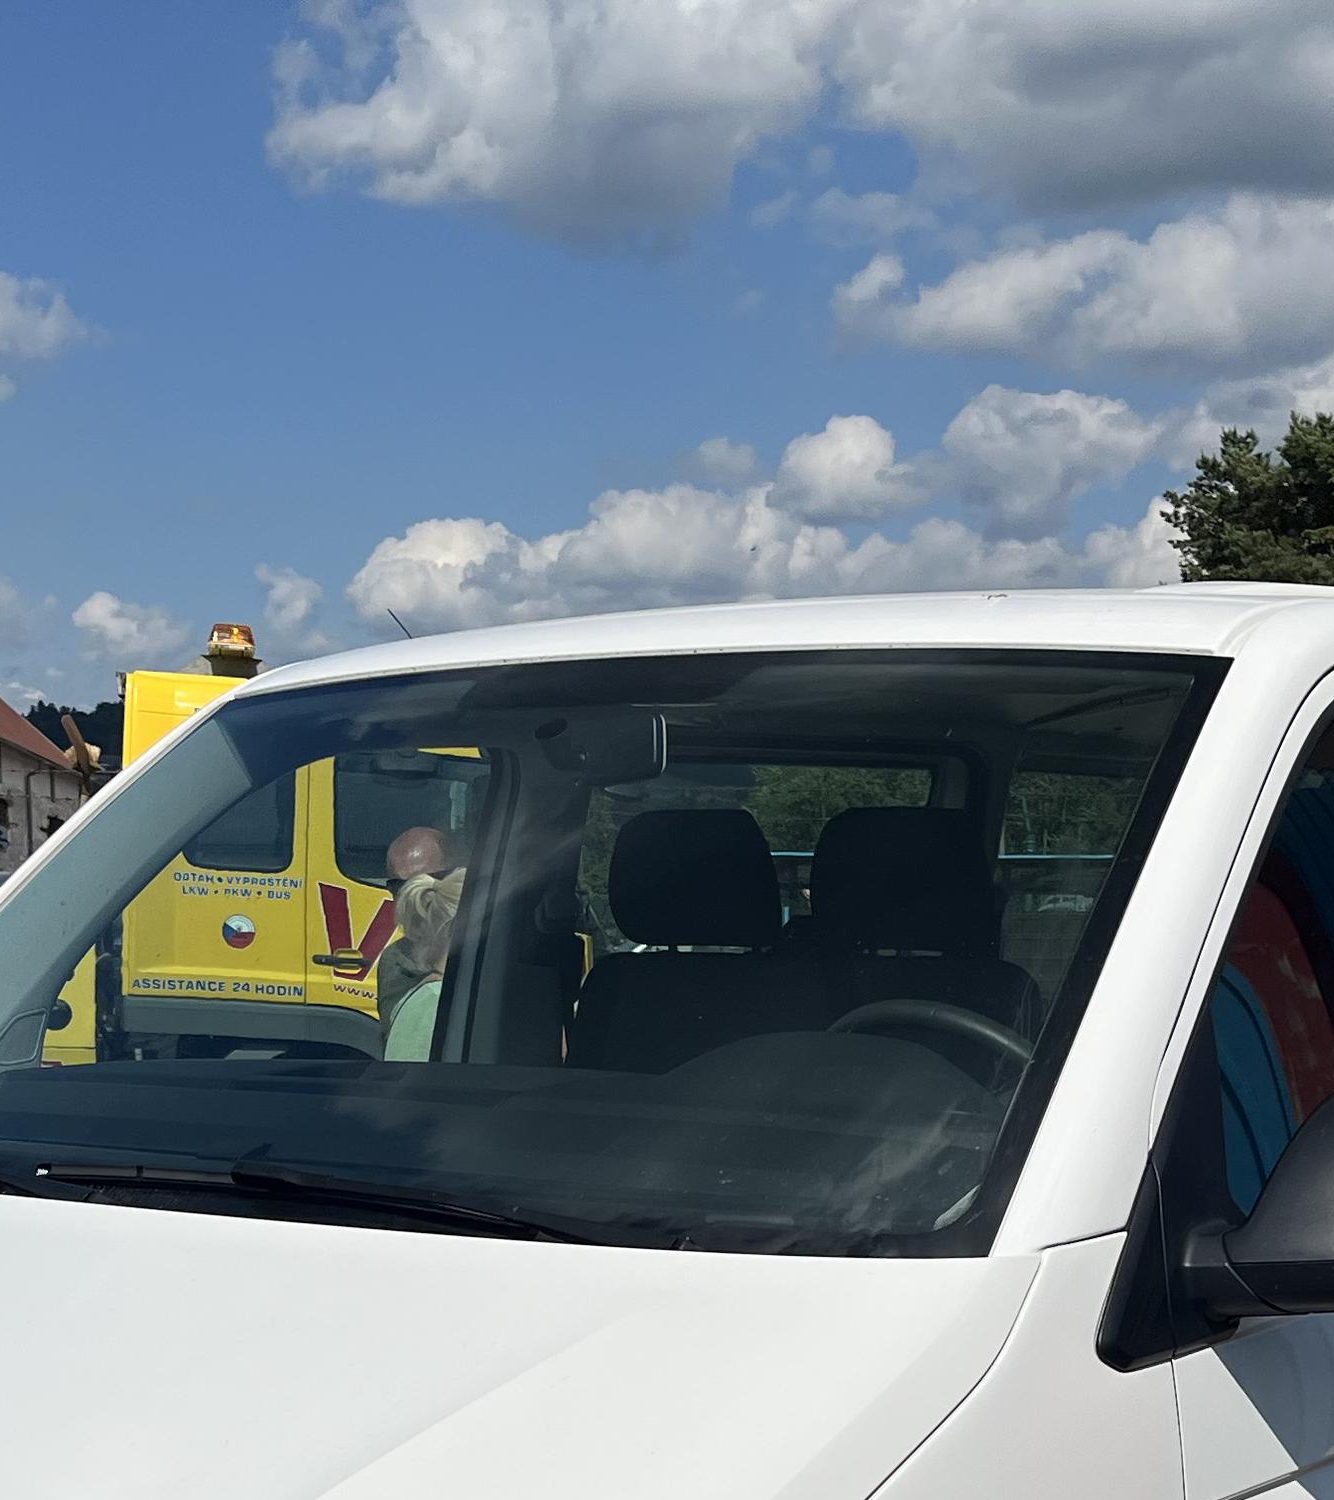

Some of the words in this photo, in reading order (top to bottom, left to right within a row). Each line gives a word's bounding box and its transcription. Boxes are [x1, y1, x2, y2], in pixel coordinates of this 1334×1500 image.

[182, 885, 208, 896] LKW
[268, 889, 291, 900] BUS
[132, 978, 226, 992] ASSISTANCE
[233, 982, 251, 993] 24
[255, 984, 303, 996] HODIN
